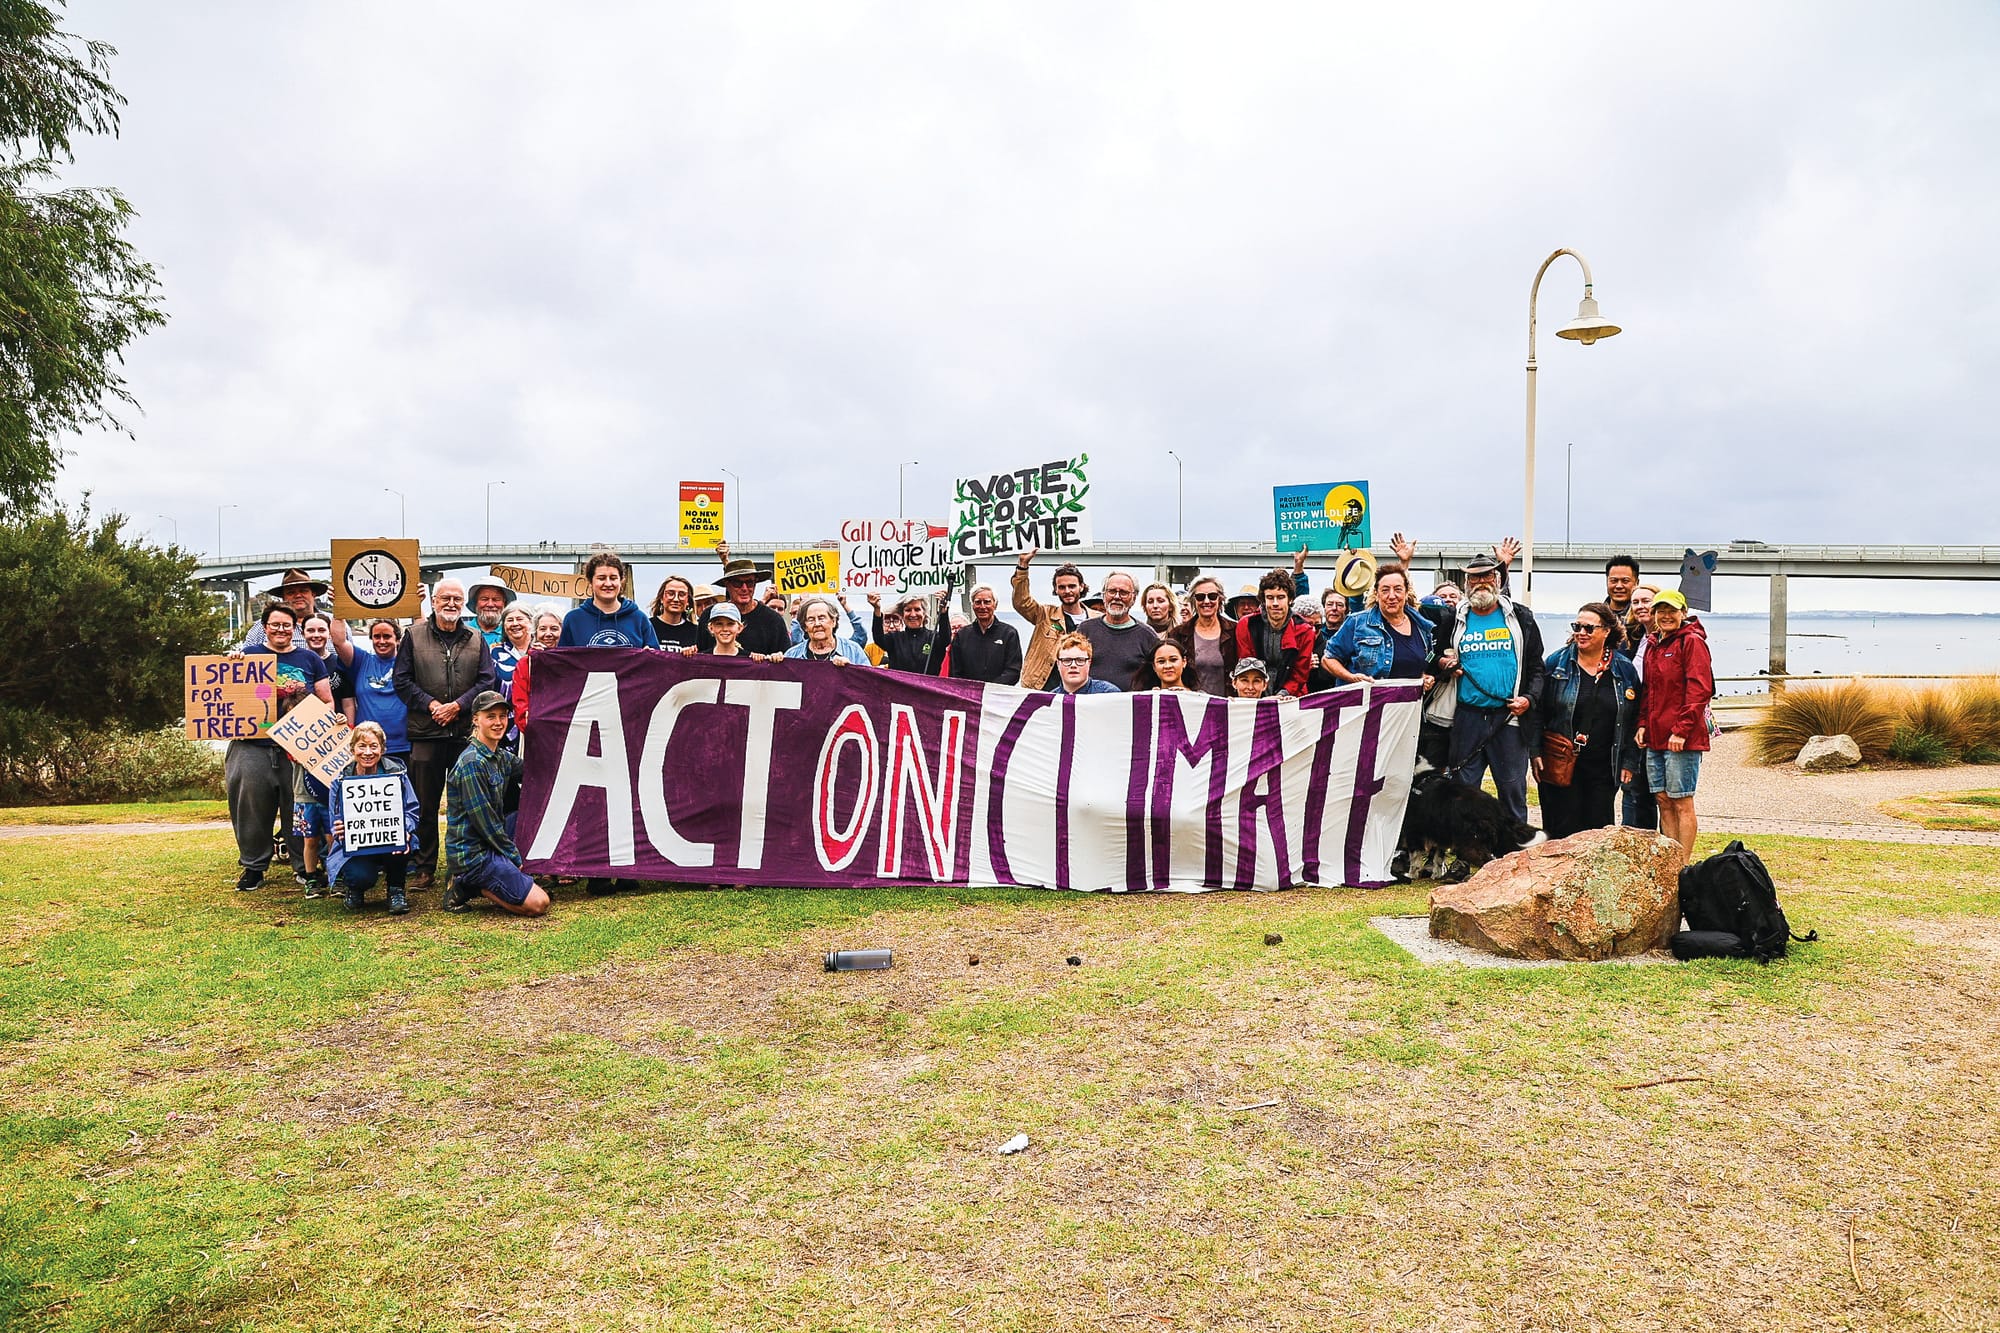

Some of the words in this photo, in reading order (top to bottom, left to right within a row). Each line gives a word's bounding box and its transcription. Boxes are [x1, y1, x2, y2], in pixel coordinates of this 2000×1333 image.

[967, 460, 1068, 503] VOTE
[1279, 495, 1309, 503] PROTECT
[1279, 501, 1305, 509] NATURE
[978, 495, 1040, 526] FOR
[1280, 510, 1308, 520] STOP
[1310, 507, 1359, 518] WILDLIFE
[841, 520, 872, 542] Call
[880, 519, 915, 543] Out
[1280, 519, 1344, 531] EXTINCTION
[957, 516, 1081, 556] CLIMTE
[777, 553, 823, 569] CLIMATE
[851, 542, 924, 569] Climate
[930, 541, 964, 566] Li
[785, 561, 825, 577] ACTION
[844, 568, 871, 587] for
[871, 567, 896, 587] the
[543, 580, 569, 594] NOT
[780, 569, 826, 591] NOW
[360, 588, 374, 596] FOR
[376, 587, 397, 596] COAL
[1461, 652, 1512, 660] NDEPENDENT
[190, 664, 197, 686] I
[205, 660, 275, 685] SPEAK
[191, 687, 223, 703] FOR
[203, 702, 235, 717] THE
[192, 716, 258, 739] TREES
[273, 715, 304, 741] THE
[295, 710, 338, 751] OCEAN
[306, 756, 318, 767] IS
[314, 734, 338, 758] NOT
[336, 726, 349, 741] OUR
[525, 671, 803, 869] ACT
[812, 704, 967, 882] ON
[353, 800, 392, 813] VOTE
[347, 819, 366, 830] FOR
[370, 816, 400, 828] THEIR
[350, 830, 398, 845] FUTURE
